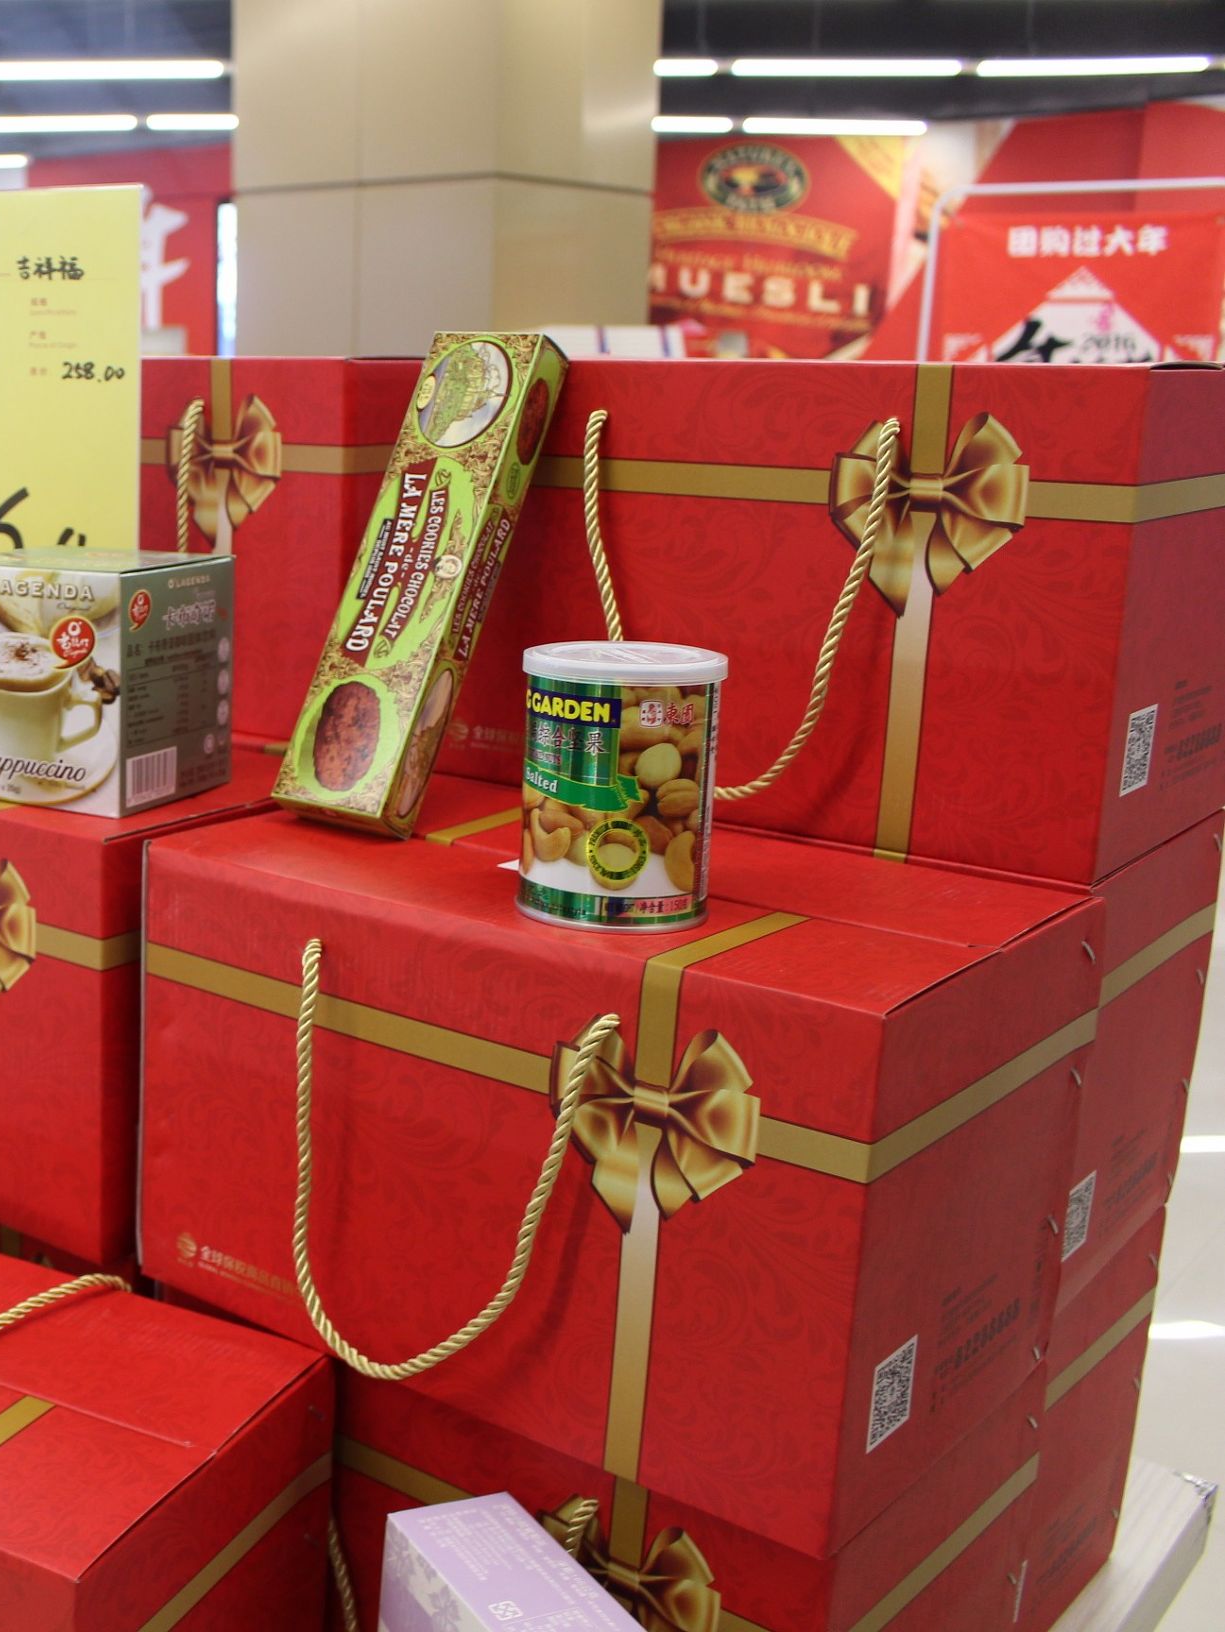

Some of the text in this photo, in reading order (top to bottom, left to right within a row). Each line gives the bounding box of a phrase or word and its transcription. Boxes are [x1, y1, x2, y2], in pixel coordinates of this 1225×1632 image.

[1007, 224, 1169, 258] 团购过大年
[17, 256, 85, 281] 吉祥福
[62, 361, 126, 383] 258.00
[402, 473, 427, 499] LA
[384, 490, 446, 641] LES COOKIES CHOCOLAT
[345, 561, 399, 653] POULARD
[532, 692, 611, 723] GARDEN
